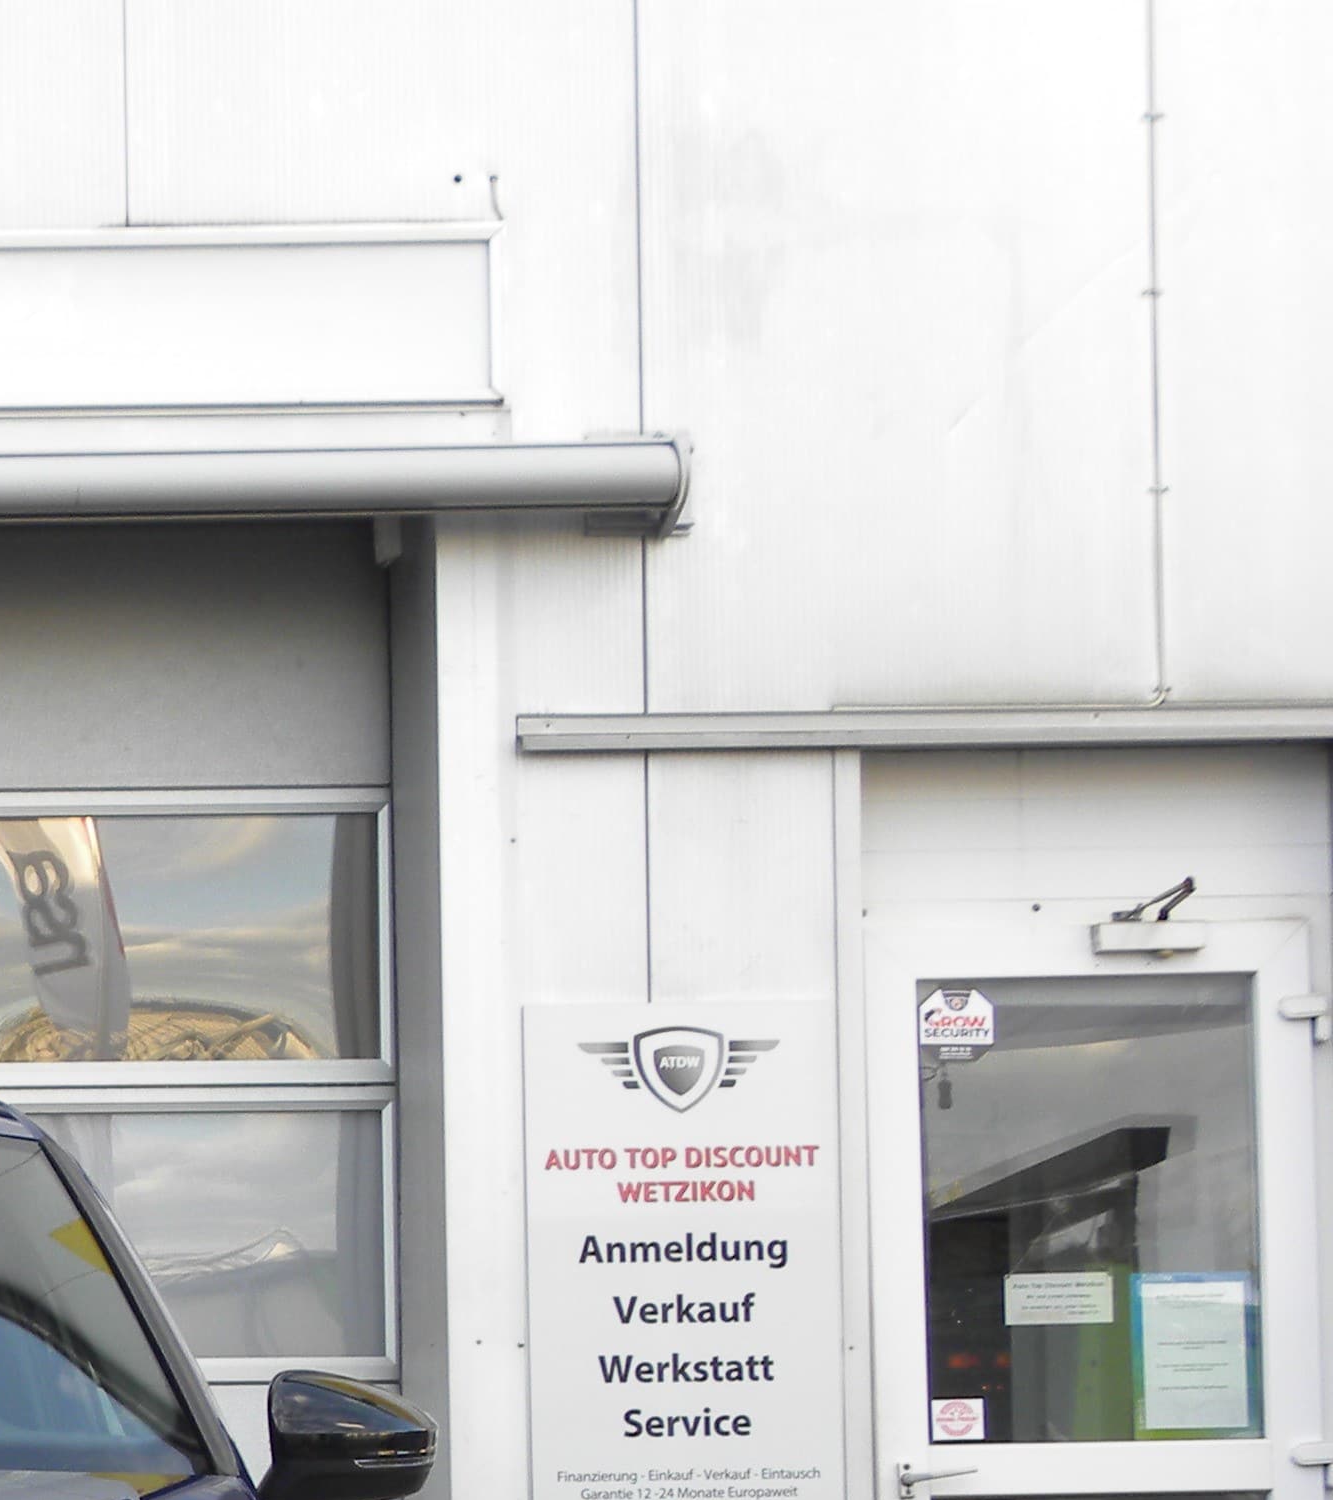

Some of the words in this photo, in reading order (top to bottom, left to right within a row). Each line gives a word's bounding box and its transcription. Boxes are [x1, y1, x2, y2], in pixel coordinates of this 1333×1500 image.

[924, 1028, 990, 1038] SECURITY
[659, 1055, 701, 1069] ATDW
[545, 1148, 618, 1171] AUTO
[624, 1147, 677, 1169] TOP
[684, 1144, 820, 1169] DISCOUNT
[617, 1180, 755, 1203] WETZIKON
[579, 1232, 789, 1269] Anmeldung
[613, 1293, 756, 1324] Verkauf
[598, 1354, 775, 1384] Werkstatt
[623, 1408, 752, 1438] Service
[557, 1470, 638, 1485] Finanzierung
[648, 1469, 694, 1482] Einkauf
[703, 1468, 751, 1481] Verkauf
[761, 1467, 821, 1481] Eintausch
[580, 1487, 634, 1500] Garantie
[637, 1487, 651, 1500] 12
[677, 1486, 725, 1499] Monate
[728, 1486, 798, 1500] Europaweit
